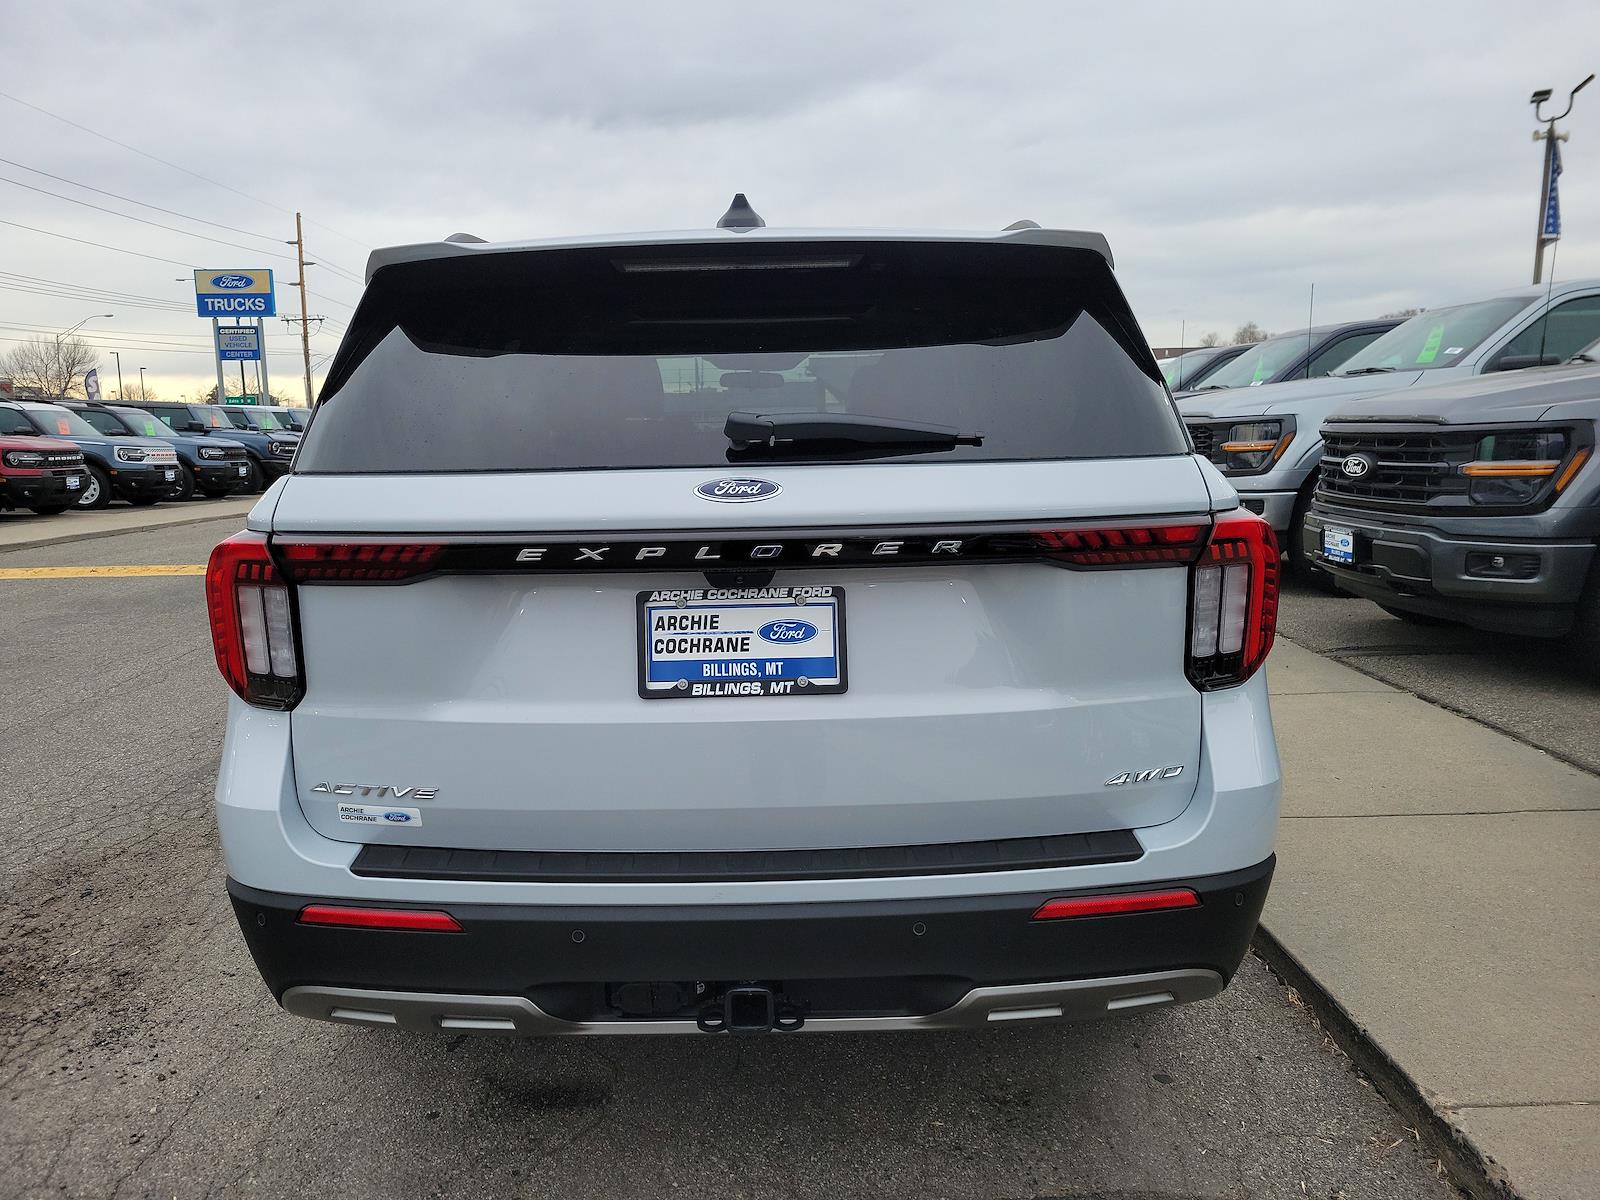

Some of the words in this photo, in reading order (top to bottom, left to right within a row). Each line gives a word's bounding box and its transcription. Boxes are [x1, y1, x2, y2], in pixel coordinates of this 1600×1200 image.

[205, 298, 265, 311] TRUCKS
[515, 540, 963, 562] EXPLORER
[650, 589, 704, 602] ARCHIE
[707, 588, 788, 600] COCHRANE
[791, 586, 833, 598] FORD
[654, 614, 720, 632] ARCHIE
[654, 636, 751, 655] COCHRANE
[702, 663, 762, 678] BILLINGS,
[765, 661, 784, 676] MT
[691, 683, 765, 696] BILLINGS,
[769, 681, 794, 694] MT
[1104, 764, 1184, 786] 4WD
[310, 781, 440, 800] ACTIVE
[340, 806, 365, 814] ARCHIE
[340, 814, 378, 823] COCHRANE
